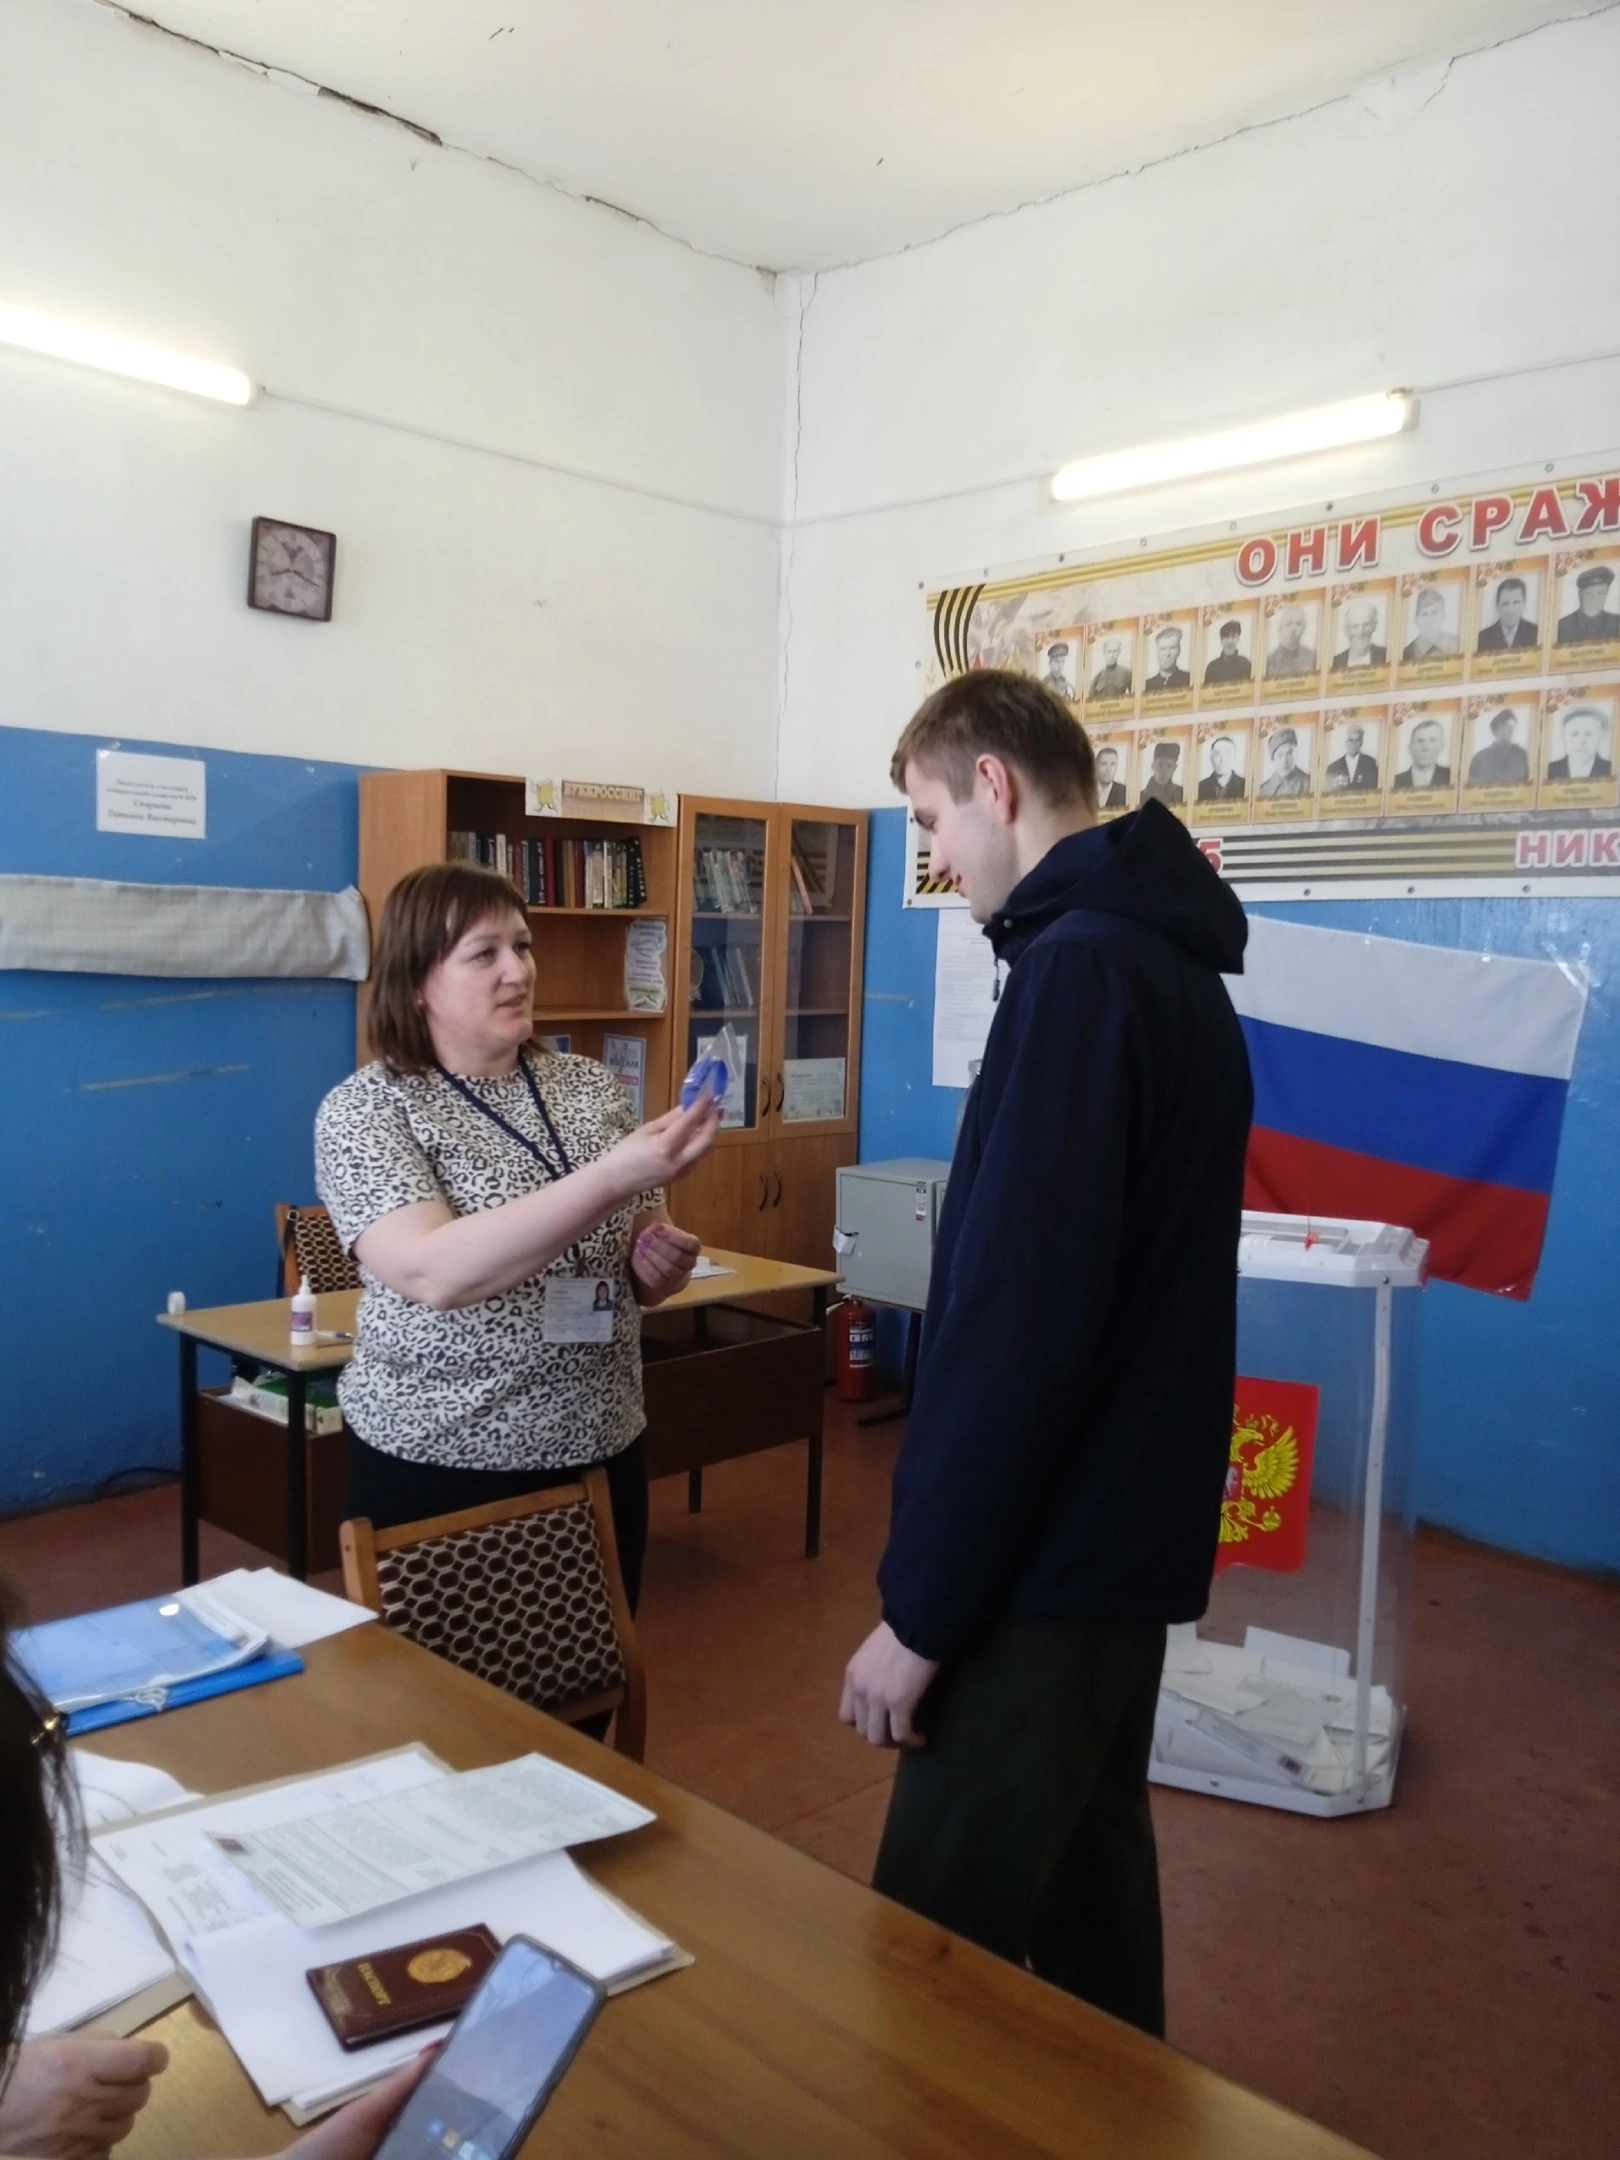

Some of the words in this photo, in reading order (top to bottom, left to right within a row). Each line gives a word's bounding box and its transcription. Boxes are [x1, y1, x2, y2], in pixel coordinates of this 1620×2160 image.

[1236, 516, 1381, 584] ОНИ
[1417, 477, 1620, 556] СРАЖ
[1516, 829, 1620, 868] НИК
